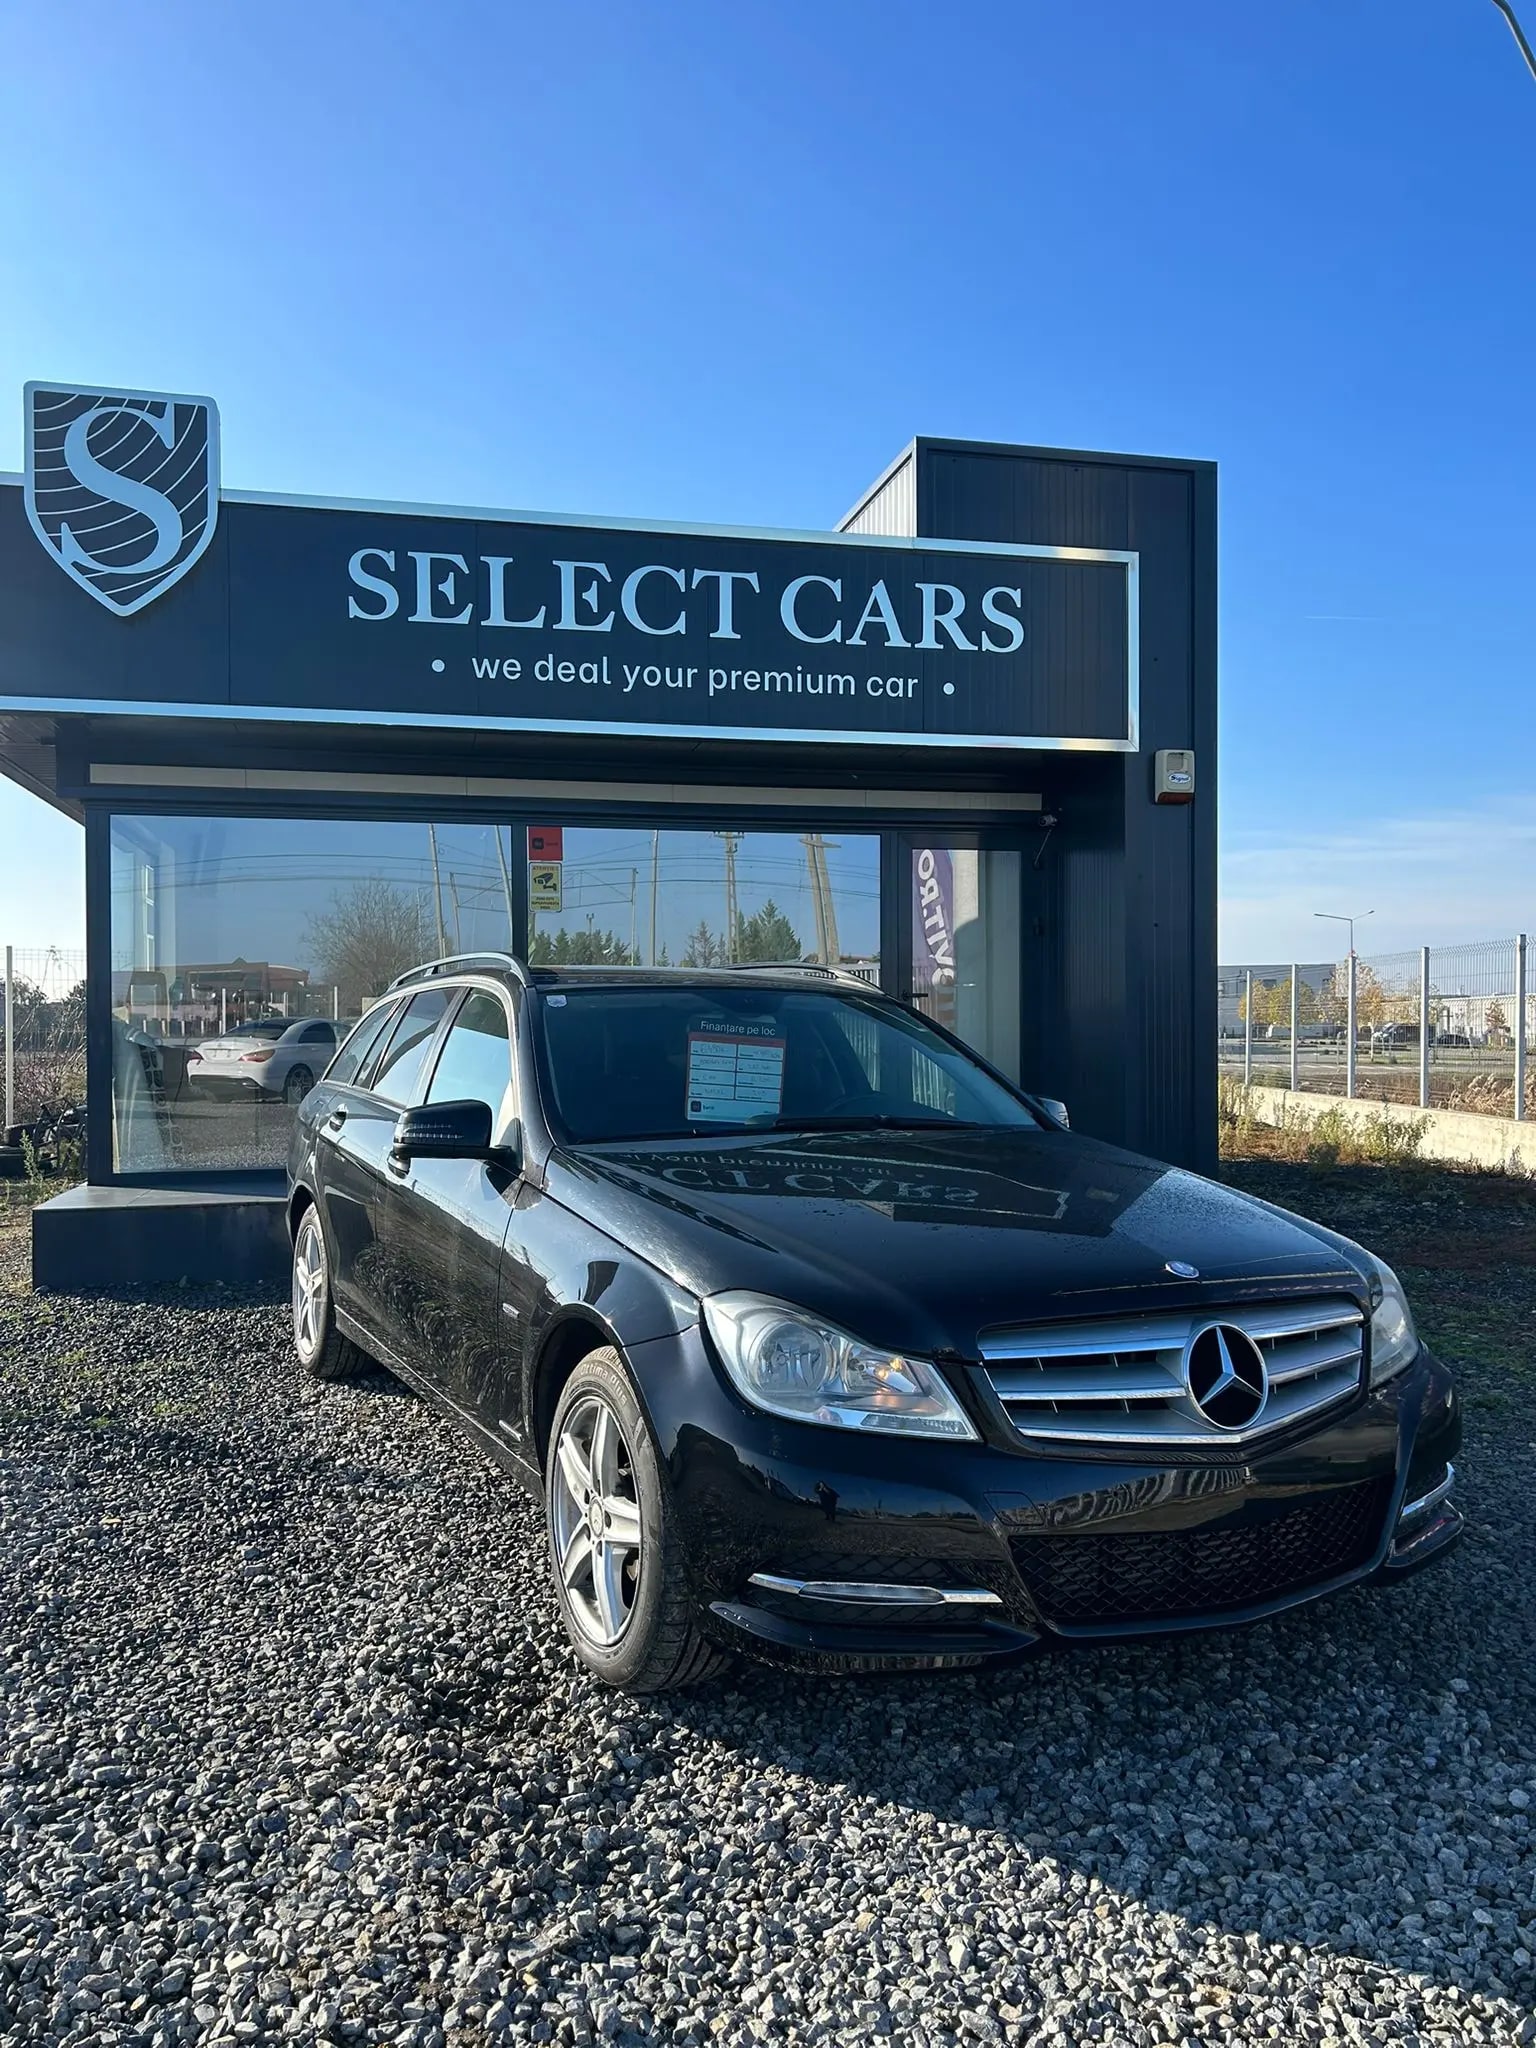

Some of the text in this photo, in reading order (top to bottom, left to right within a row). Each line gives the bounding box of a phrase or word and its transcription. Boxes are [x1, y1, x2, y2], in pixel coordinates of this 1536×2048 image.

[348, 548, 1025, 653] SELECT CARS
[472, 653, 919, 698] we deal your premium car
[700, 1020, 776, 1036] Finanțare pe loc
